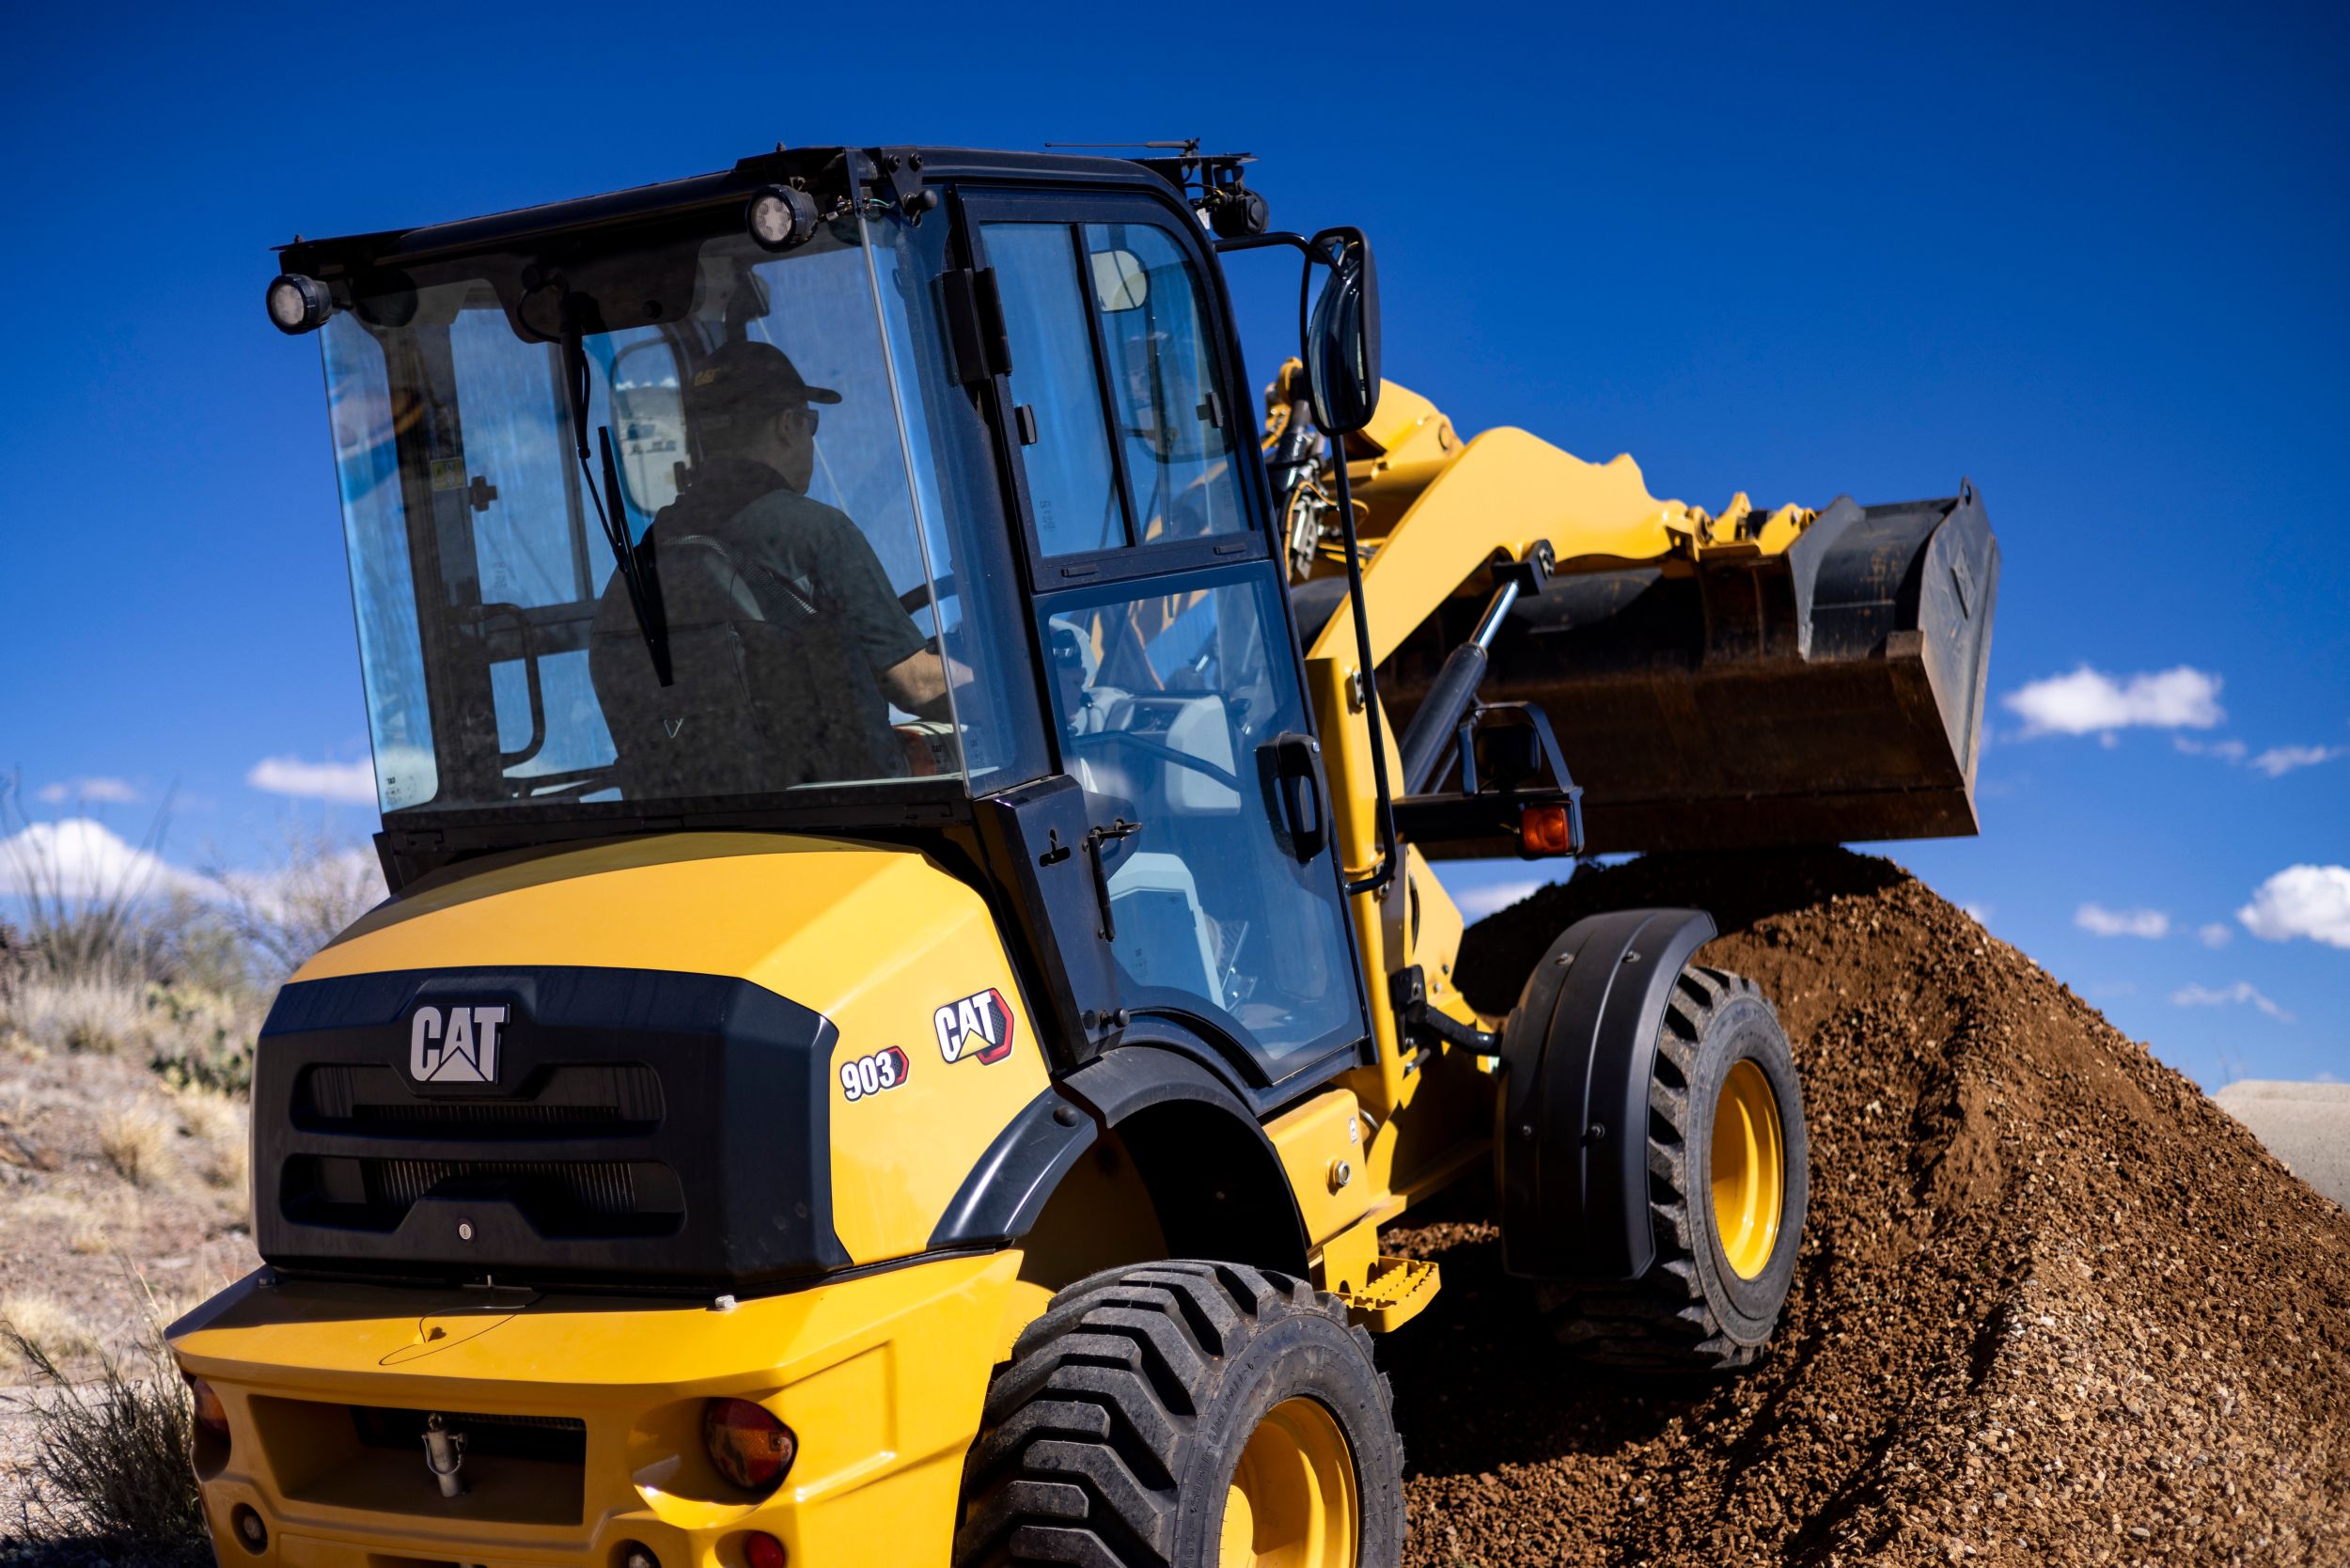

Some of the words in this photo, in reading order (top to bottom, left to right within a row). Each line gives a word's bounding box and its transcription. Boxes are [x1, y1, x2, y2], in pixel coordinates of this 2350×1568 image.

[410, 1006, 506, 1082] CAT
[934, 991, 996, 1063] CAT
[840, 1051, 896, 1100] 903
